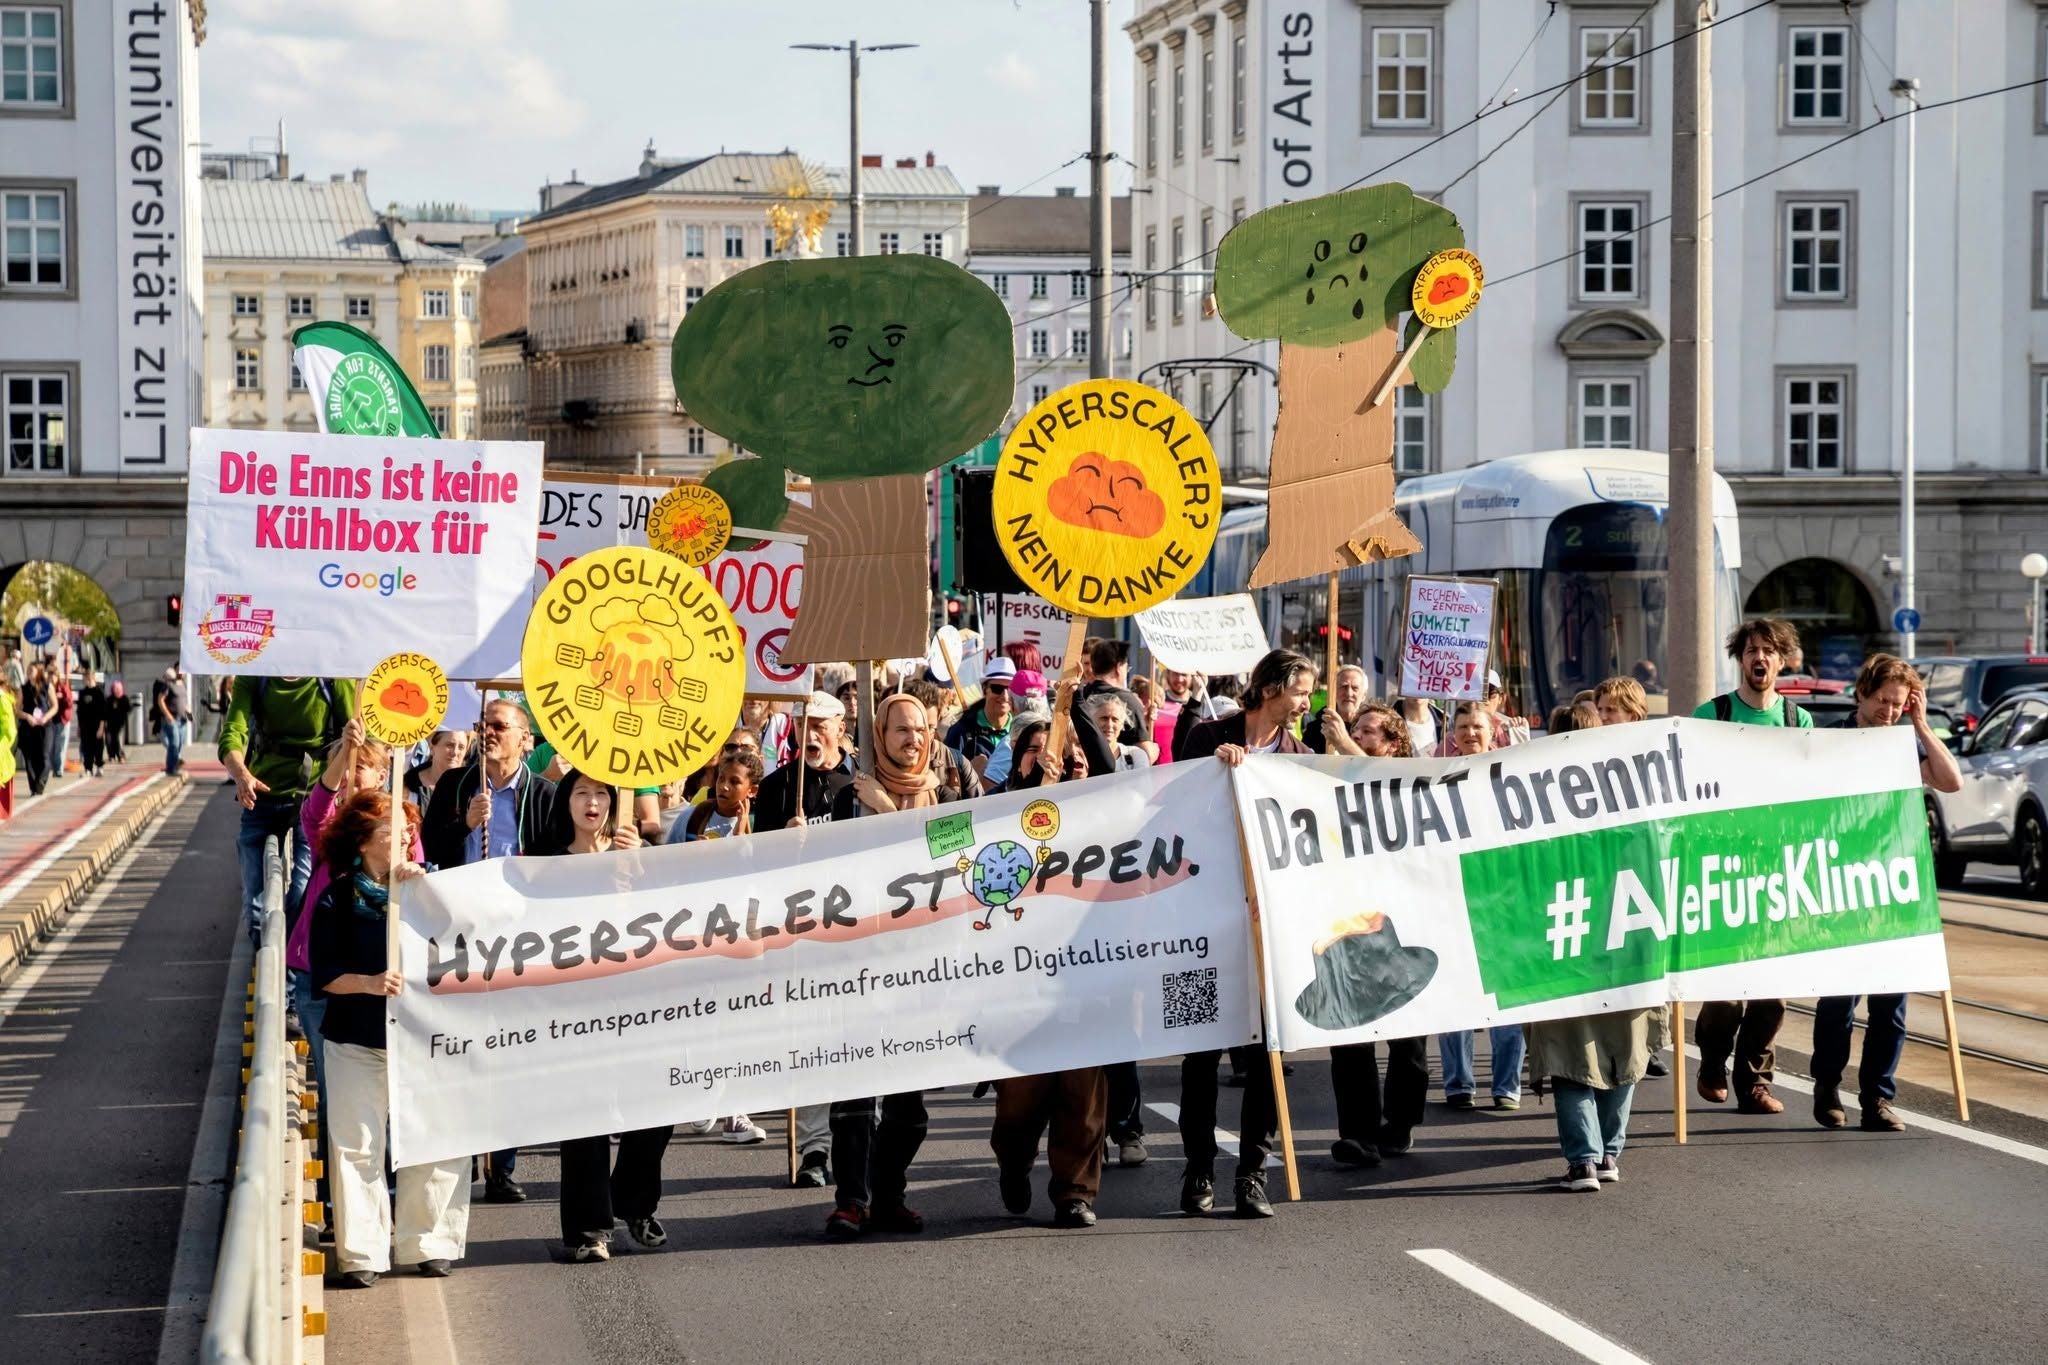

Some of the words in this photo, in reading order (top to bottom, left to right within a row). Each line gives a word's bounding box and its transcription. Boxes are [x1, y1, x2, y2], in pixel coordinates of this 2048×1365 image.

[1273, 12, 1313, 127] Arts
[1273, 137, 1312, 188] of
[1413, 250, 1484, 301] HYPERSCALER?
[1419, 307, 1435, 324] NO
[1438, 289, 1481, 327] THANKS
[219, 450, 278, 495] Die
[289, 454, 372, 500] Enns
[382, 456, 425, 501] ist
[431, 459, 519, 503] keine
[1008, 391, 1211, 530] HYPERSCALER?
[255, 504, 421, 553] Kühlbox
[431, 511, 489, 555] für
[619, 494, 657, 532] JA
[648, 487, 724, 539] GOOGLHUPF?
[1565, 525, 1584, 548] 2
[694, 518, 729, 562] DANKE
[1007, 513, 1073, 593] NEIN
[1077, 540, 1194, 606] DANKE
[318, 563, 418, 597] Google
[1418, 587, 1466, 603] RECHEN-
[208, 621, 235, 634] UNSER
[236, 621, 266, 636] TRAUN
[546, 557, 735, 665] GOOGLHUPF?
[1411, 613, 1471, 633] UMWELT
[1411, 646, 1460, 661] PRÜFUNG
[1420, 659, 1464, 677] MUSS
[366, 654, 448, 715] HYPERSCALER?
[1418, 675, 1452, 693] HER
[362, 703, 387, 738] NEIN
[387, 717, 437, 744] DANKE
[536, 680, 600, 761] NEIN
[608, 716, 717, 777] DANKE
[928, 822, 970, 842] Kronstorf
[938, 819, 954, 829] Von
[1254, 796, 1324, 872] Da
[1334, 767, 1470, 859] HUAT
[940, 836, 965, 851] lernen!
[426, 883, 858, 988] HYPERSCALER
[430, 1033, 473, 1059] Für
[484, 1023, 538, 1051] eine
[548, 996, 717, 1038] transparente
[727, 982, 775, 1012] und
[784, 951, 1006, 1003] klimafreundliche
[1014, 935, 1210, 977] Digitalisierung
[668, 1059, 783, 1090] Bürger:innen
[788, 1041, 875, 1072] Initiative
[881, 1023, 977, 1058] Kronstorf
